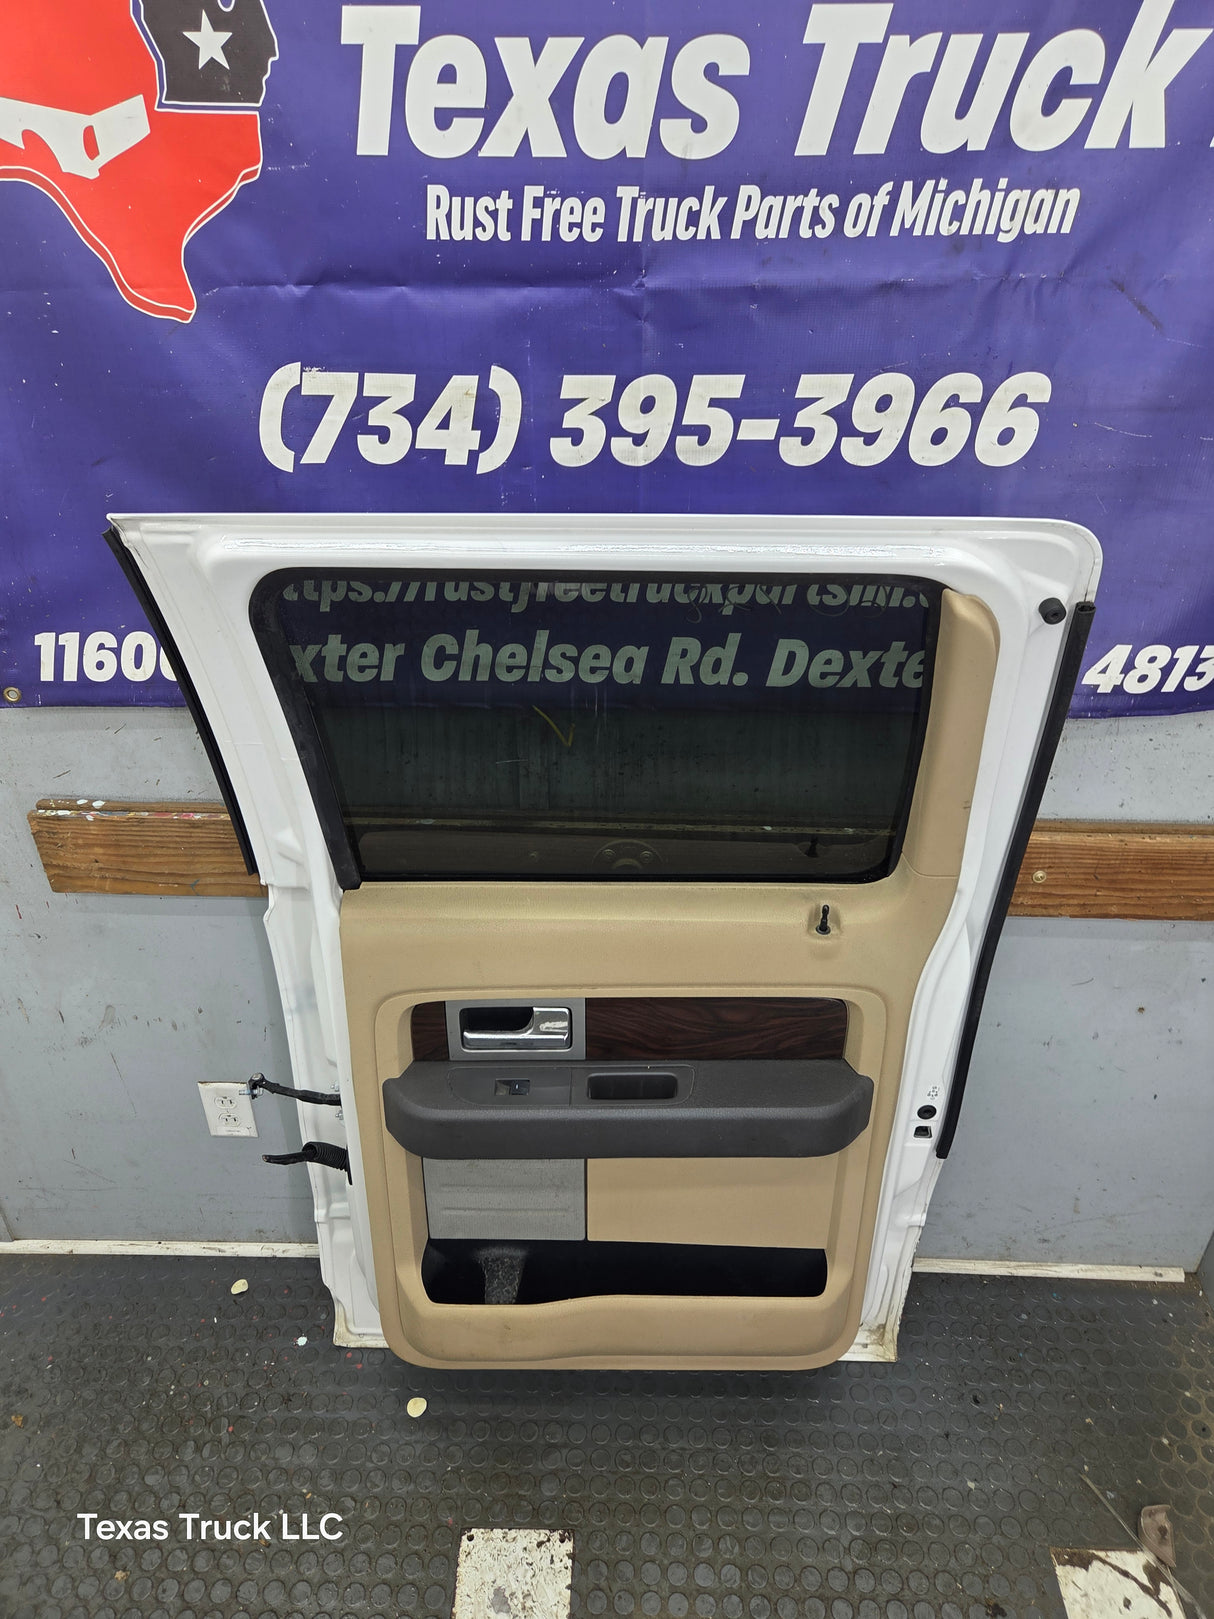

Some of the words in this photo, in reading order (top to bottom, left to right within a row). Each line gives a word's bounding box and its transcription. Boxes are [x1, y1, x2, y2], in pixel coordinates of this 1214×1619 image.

[341, 5, 750, 159] Texas
[794, 0, 1214, 156] Truck
[427, 184, 513, 241] Rust
[521, 185, 605, 242] Free
[616, 186, 728, 242] Truck
[730, 185, 839, 239] Parts
[844, 181, 894, 238] of
[890, 178, 1080, 243] Michigan
[259, 361, 522, 474] (734)
[550, 372, 1052, 467] 395-3966
[420, 629, 649, 684] Chelsea
[661, 633, 749, 687] Rd.
